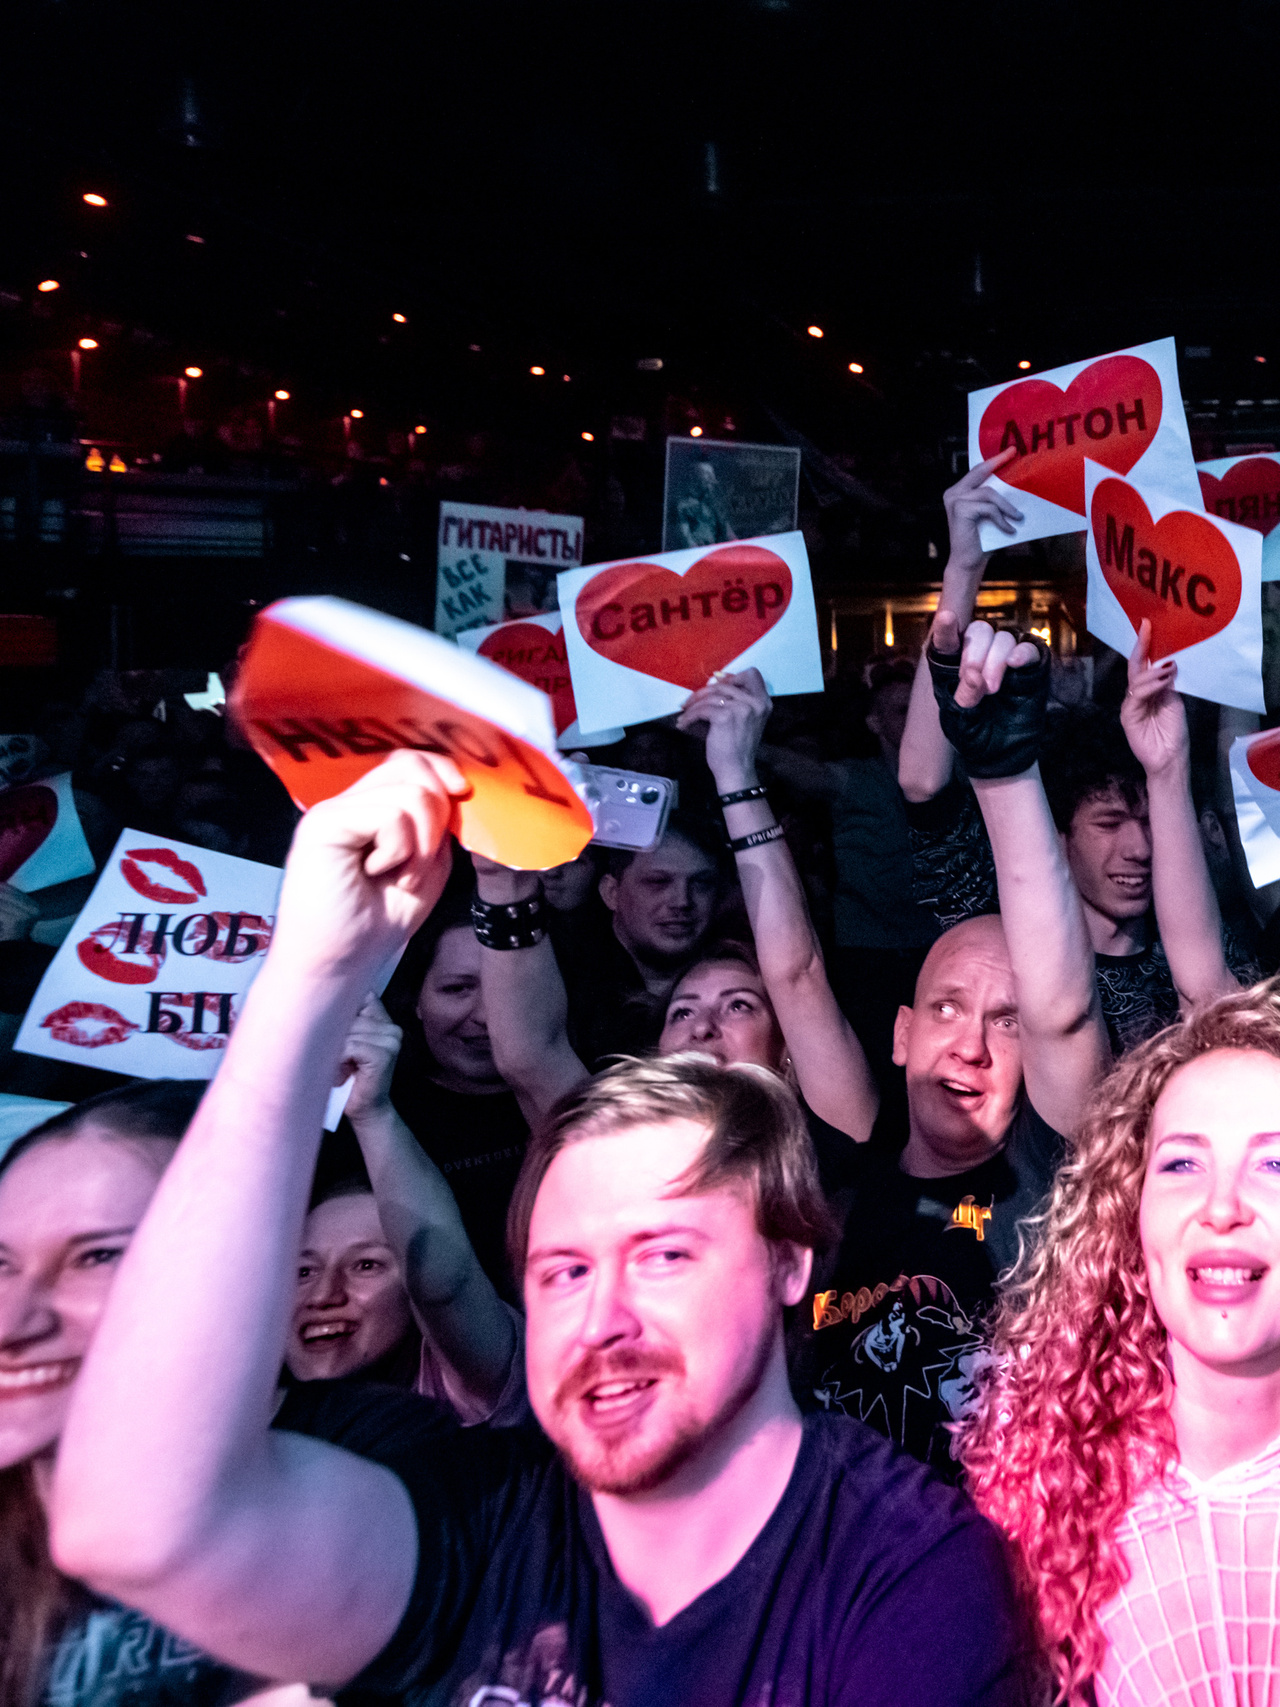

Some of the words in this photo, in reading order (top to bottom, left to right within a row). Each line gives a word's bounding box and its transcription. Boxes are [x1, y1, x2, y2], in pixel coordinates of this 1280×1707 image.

[1000, 399, 1147, 456] Антон
[442, 516, 582, 562] ГИТАРИСТЫ
[442, 553, 488, 589] ВСЕ
[1105, 513, 1217, 618] Макс
[441, 583, 491, 621] КАК
[590, 576, 786, 642] Сантёр
[109, 912, 277, 957] ЛЮБ
[142, 991, 238, 1034] БП
